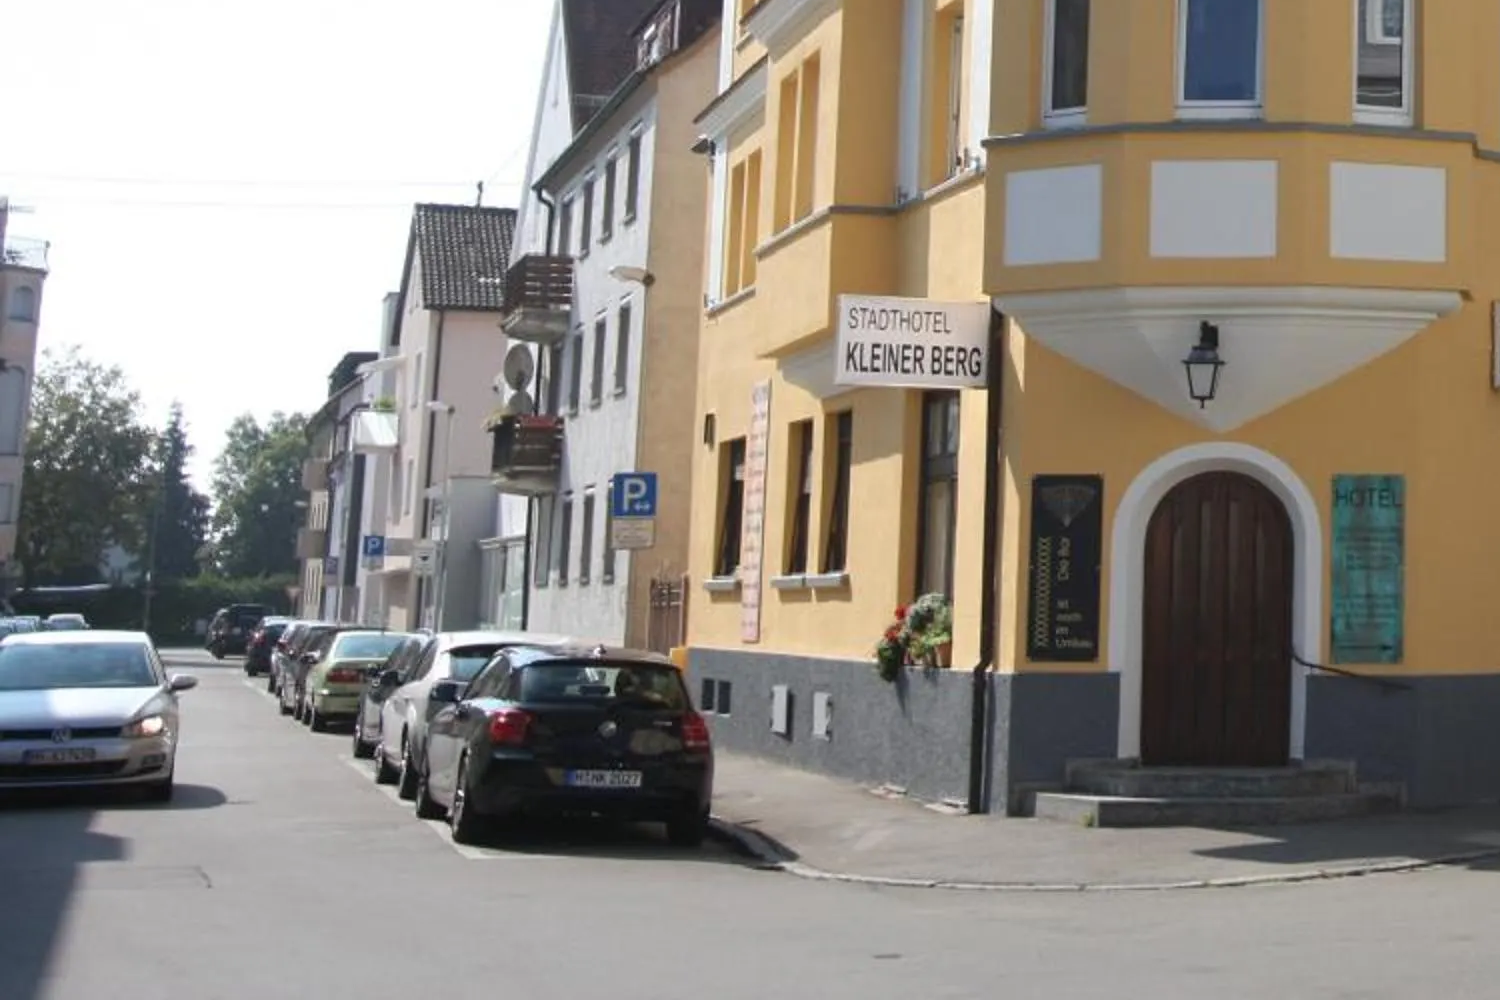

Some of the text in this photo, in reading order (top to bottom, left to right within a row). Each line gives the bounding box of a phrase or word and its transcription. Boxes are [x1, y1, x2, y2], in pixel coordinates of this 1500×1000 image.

[849, 307, 952, 334] STADTHOTEL
[846, 341, 982, 377] KLEINER BERG
[623, 478, 647, 513] P
[1334, 486, 1403, 508] HOTEL
